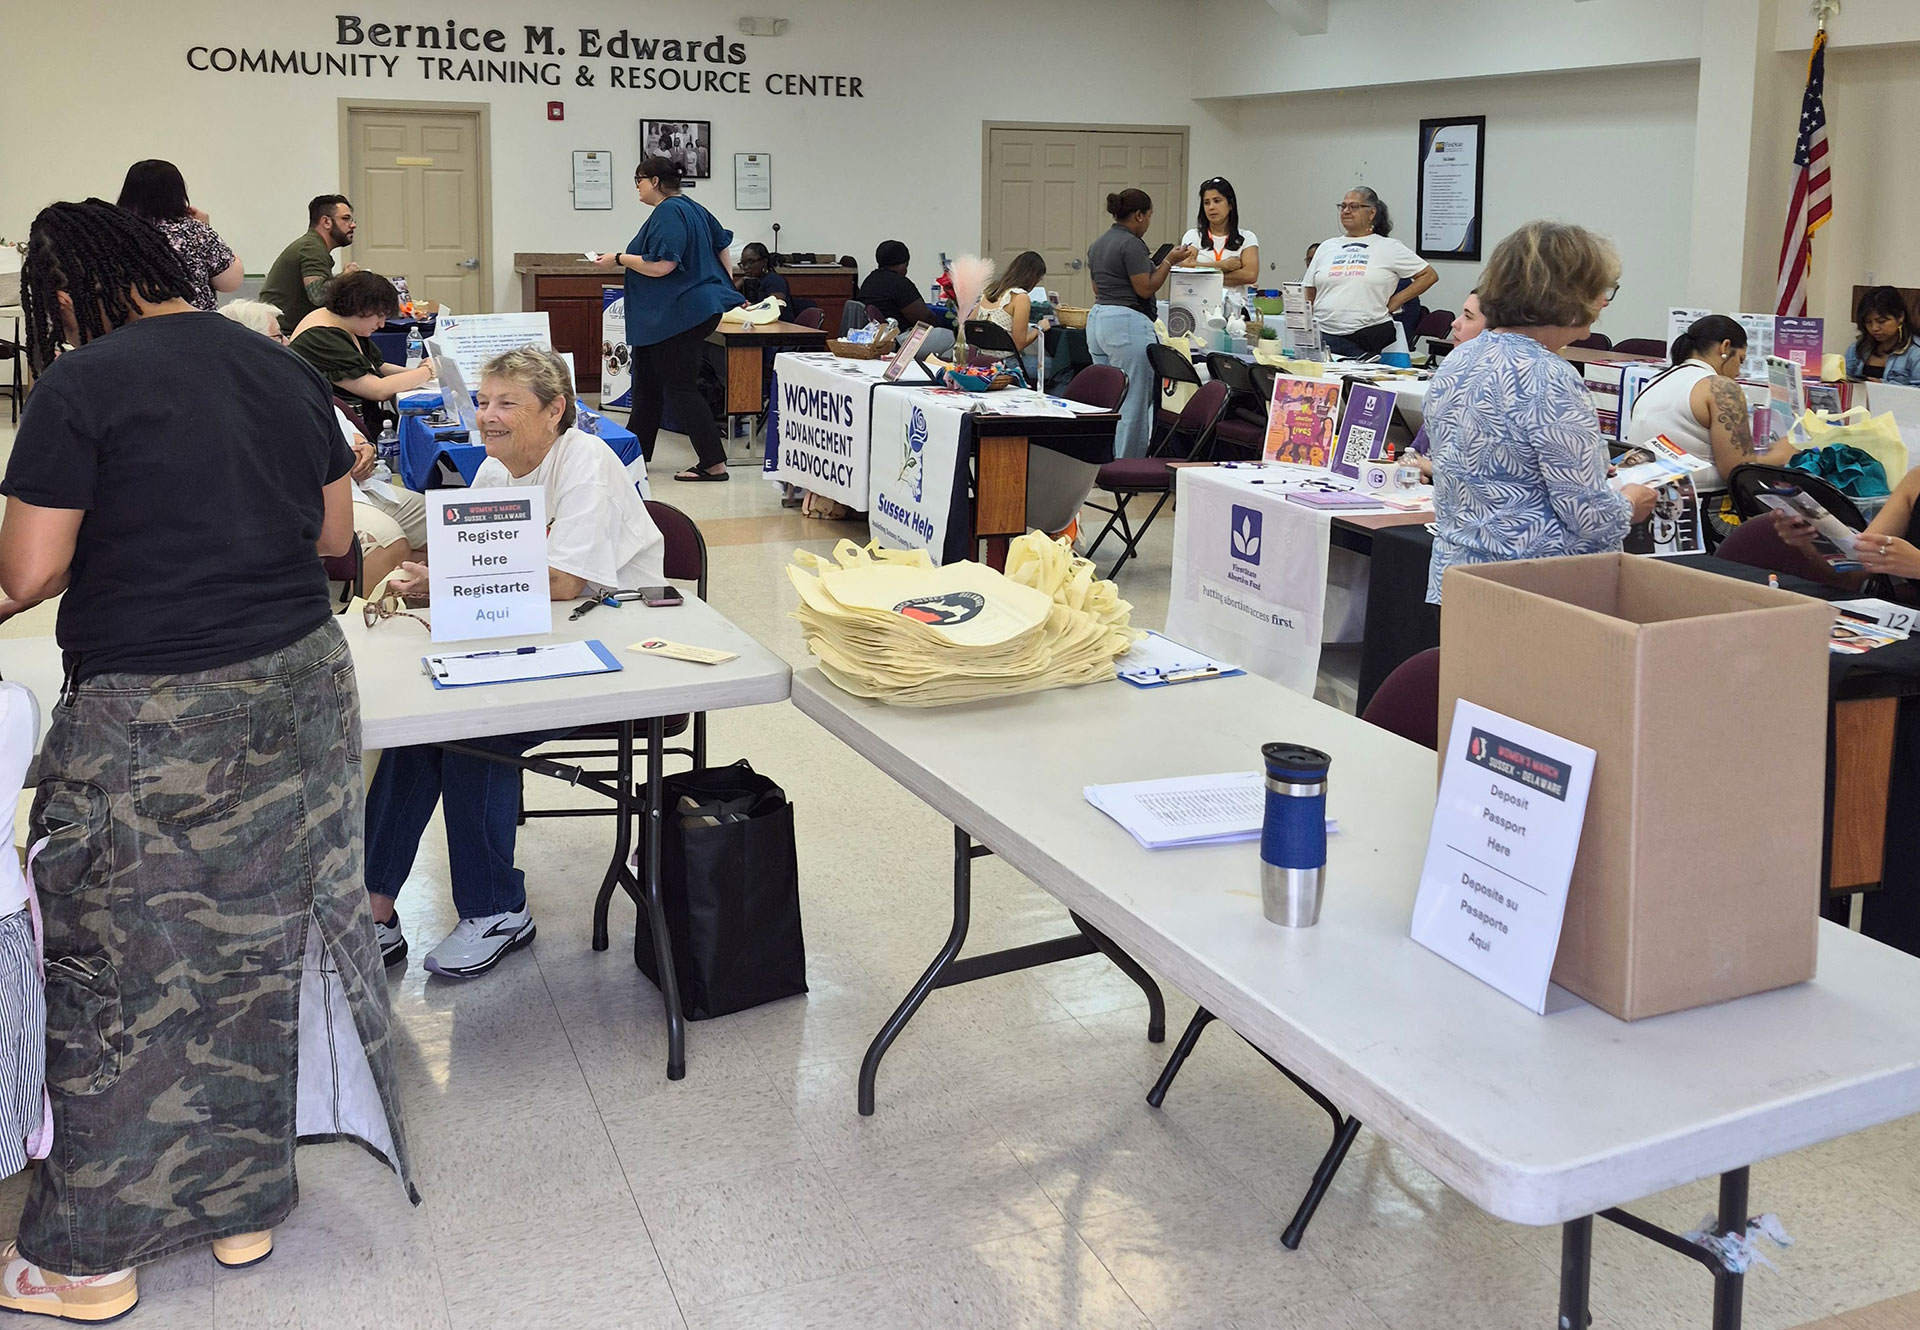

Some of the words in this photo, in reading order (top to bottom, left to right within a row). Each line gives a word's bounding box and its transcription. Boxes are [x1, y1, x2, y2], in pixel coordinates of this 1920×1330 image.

[335, 14, 506, 52] Bernice
[523, 25, 566, 56] M.
[579, 29, 747, 65] Edwards
[186, 46, 400, 79] COMMUNITY
[418, 56, 562, 87] TRAINING
[575, 64, 594, 88] &
[610, 66, 751, 95] RESOURCE
[765, 74, 864, 99] CENTER
[783, 382, 854, 428] WOMEN'S
[785, 418, 853, 459] ADVANCEMENT
[464, 514, 487, 522] SUSSEX
[493, 512, 527, 521] DELAWARE
[499, 504, 522, 512] MARCH
[877, 492, 911, 527] Sussex
[911, 511, 934, 544] Help
[457, 529, 520, 544] Register
[471, 554, 508, 567] Here
[453, 581, 530, 598] Registarte
[475, 606, 510, 623] Aqui
[1202, 584, 1223, 604] Putting
[1223, 595, 1250, 614] abortion
[1250, 607, 1270, 623] access
[1884, 612, 1909, 631] 12
[1488, 757, 1514, 777] SUSSEX
[1521, 770, 1562, 796] DELAWARE
[1531, 757, 1560, 779] MARCH
[1490, 784, 1529, 811] Deposit
[1482, 807, 1527, 837] Passport
[1487, 835, 1511, 857] Here
[1461, 872, 1505, 905] Deposite
[1505, 897, 1519, 912] su
[1460, 899, 1509, 935] Pasaporte
[1467, 931, 1491, 953] Aqui
